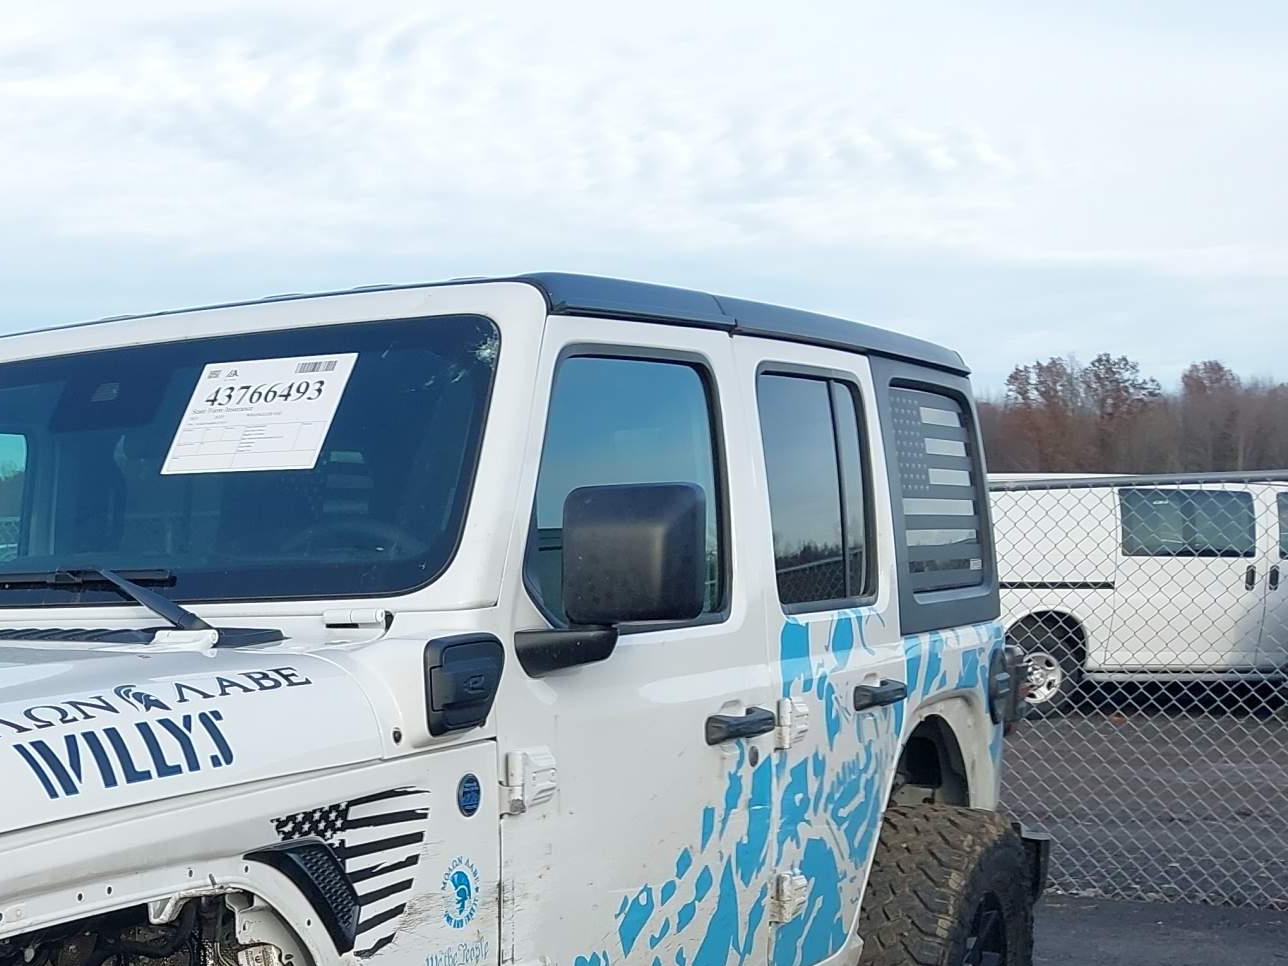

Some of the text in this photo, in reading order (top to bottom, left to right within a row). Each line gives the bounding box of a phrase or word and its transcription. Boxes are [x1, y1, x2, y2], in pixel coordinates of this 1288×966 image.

[205, 380, 325, 406] 43766493
[12, 709, 235, 800] WILLYS
[457, 935, 489, 966] People
